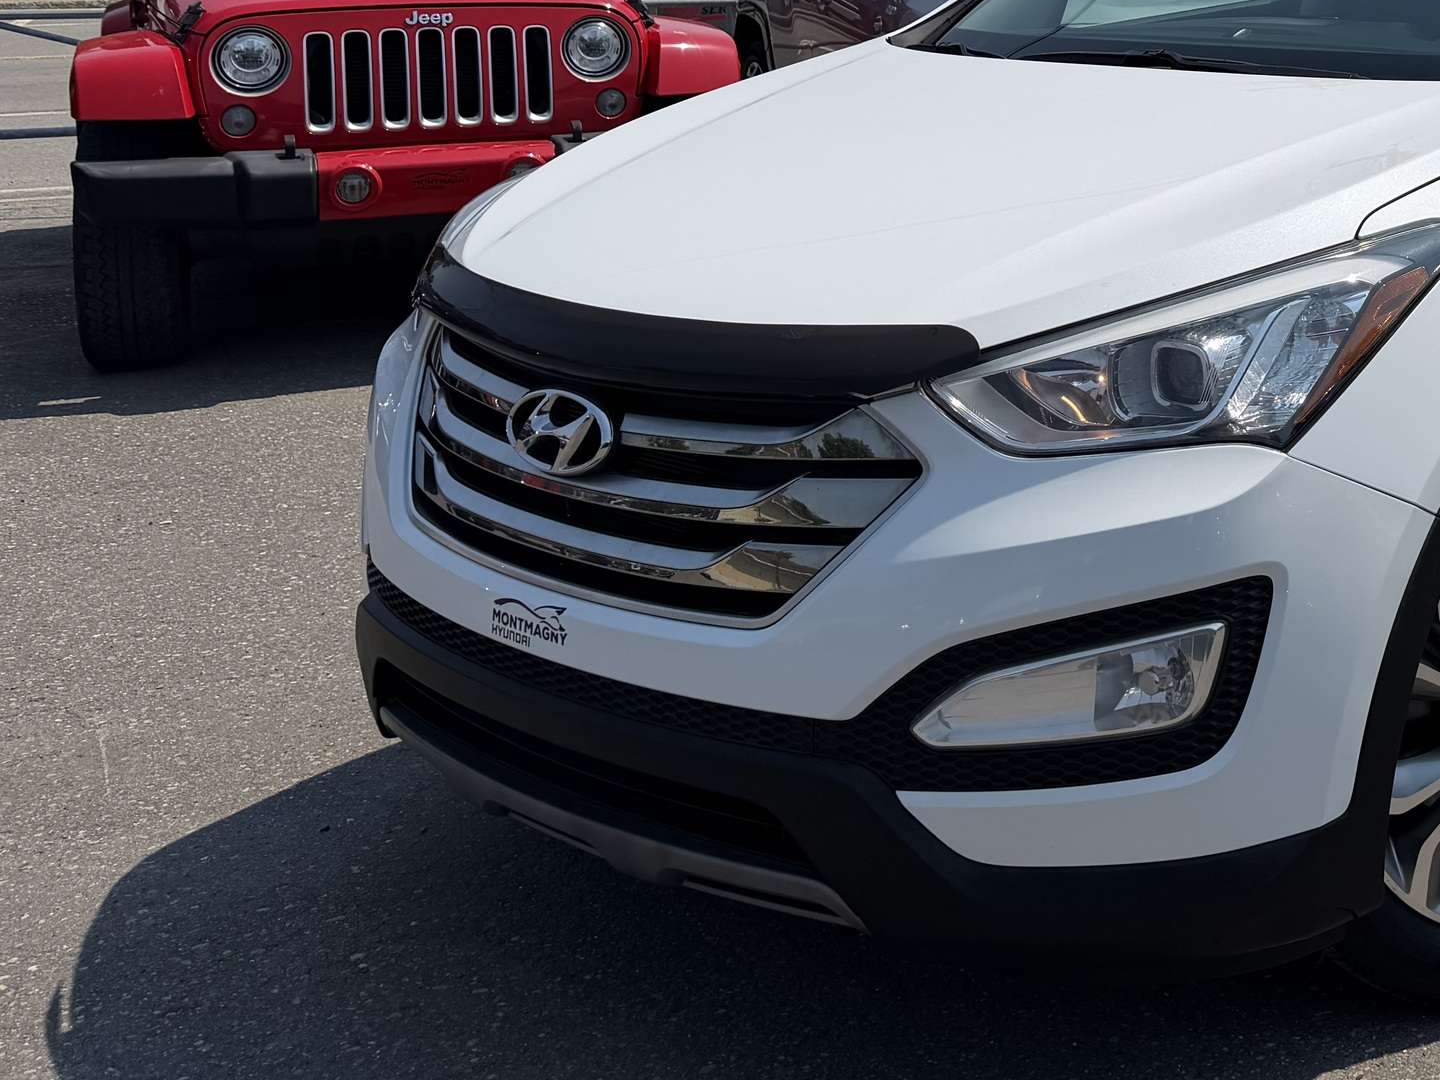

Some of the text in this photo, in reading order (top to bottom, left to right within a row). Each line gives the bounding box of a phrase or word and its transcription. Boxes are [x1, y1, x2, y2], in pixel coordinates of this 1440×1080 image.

[405, 10, 454, 27] Jeep
[491, 608, 568, 647] MONTMAGNY
[491, 623, 531, 648] HYUNDAI
